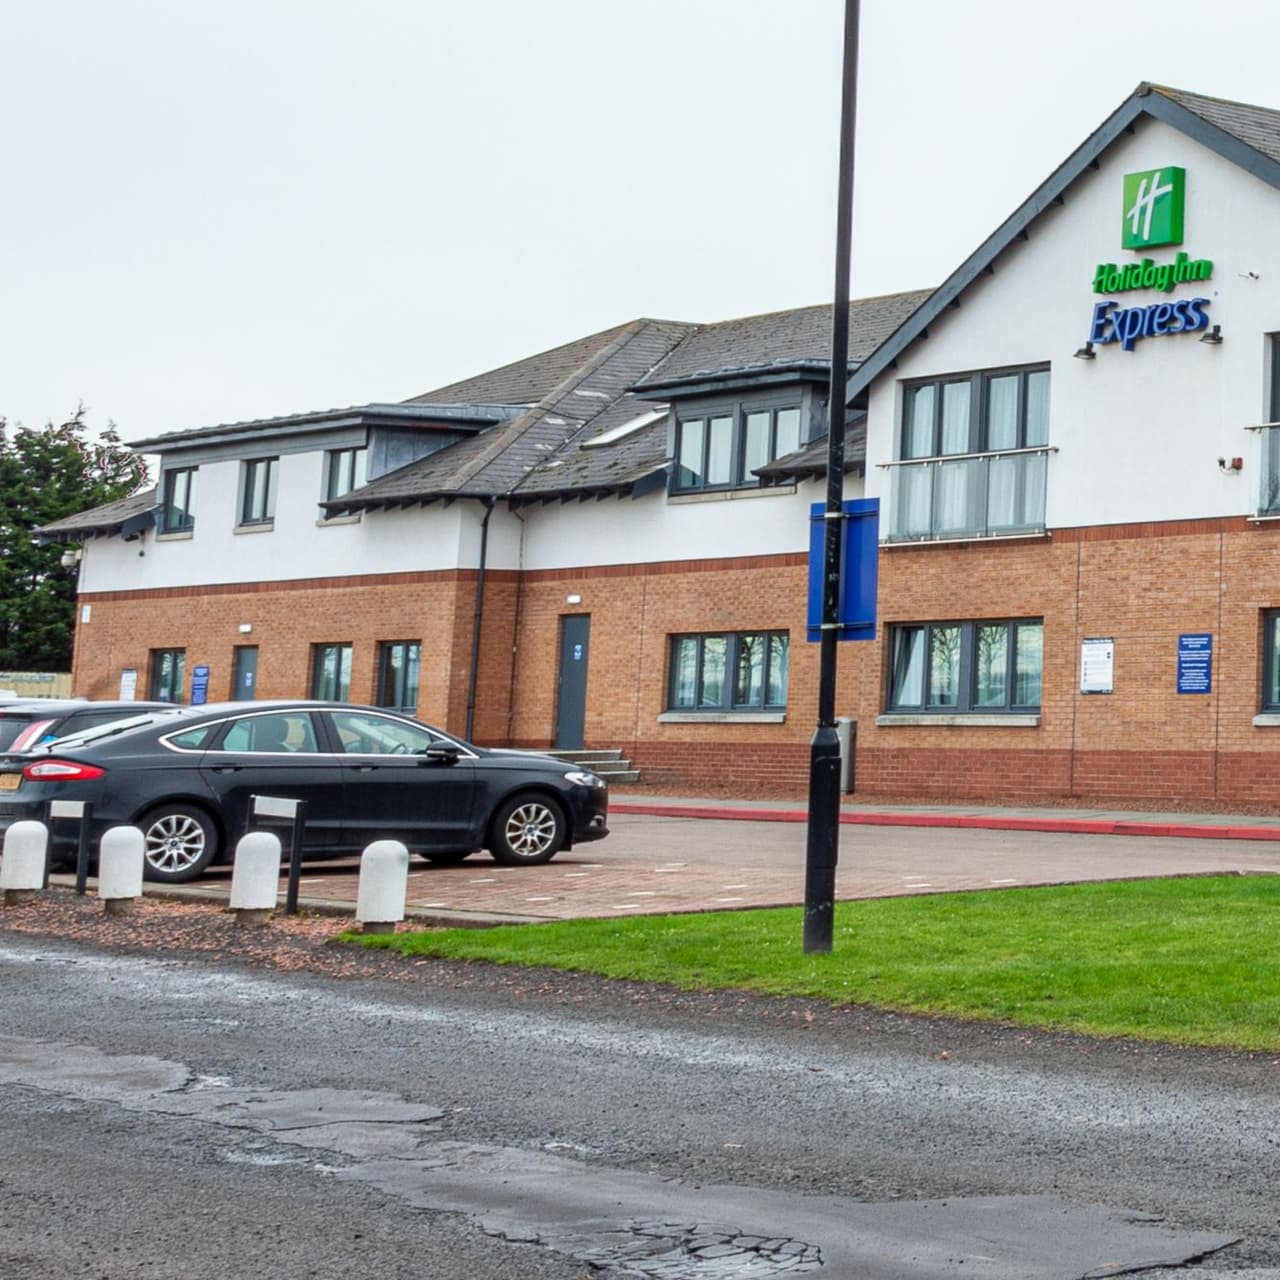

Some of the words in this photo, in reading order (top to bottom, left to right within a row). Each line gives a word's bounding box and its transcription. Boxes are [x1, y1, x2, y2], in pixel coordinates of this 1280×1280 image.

[1093, 257, 1174, 294] Holiday
[1173, 252, 1214, 281] Inn
[1090, 297, 1211, 351] Express
